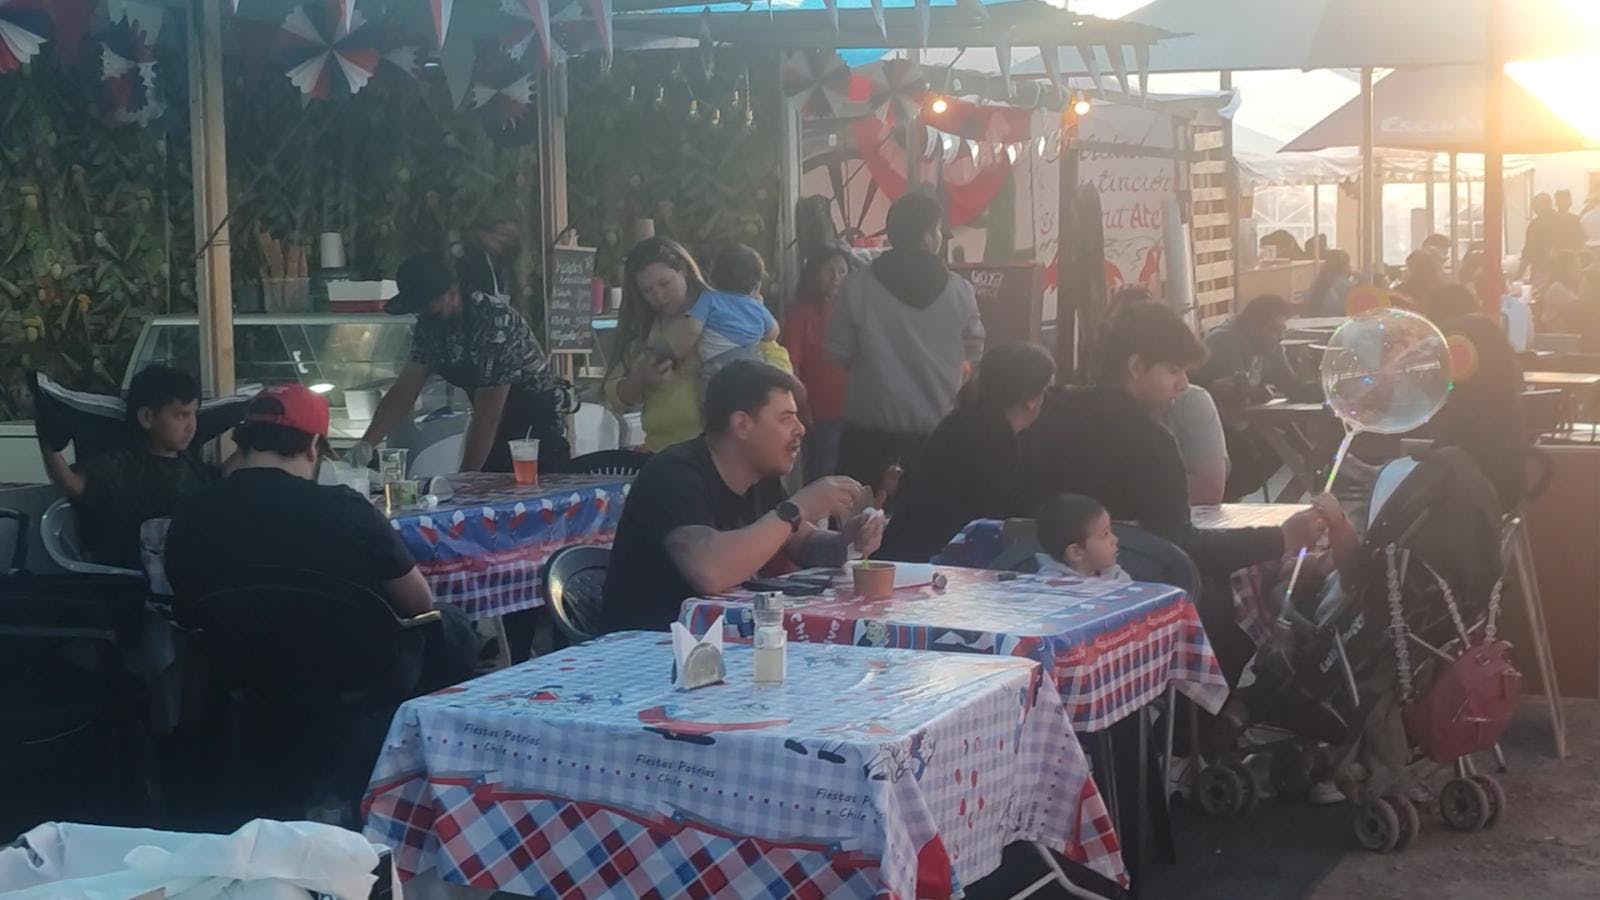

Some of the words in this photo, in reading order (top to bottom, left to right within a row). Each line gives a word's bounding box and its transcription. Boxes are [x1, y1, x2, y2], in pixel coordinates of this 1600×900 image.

[463, 723, 498, 738] Fiestas
[503, 729, 540, 746] Patrias
[484, 742, 508, 755] Chile
[636, 753, 673, 769] Fiestas
[678, 760, 715, 778] Patrias
[657, 773, 682, 787] Chile
[816, 787, 856, 804] Fiestas
[839, 808, 867, 822] Chile
